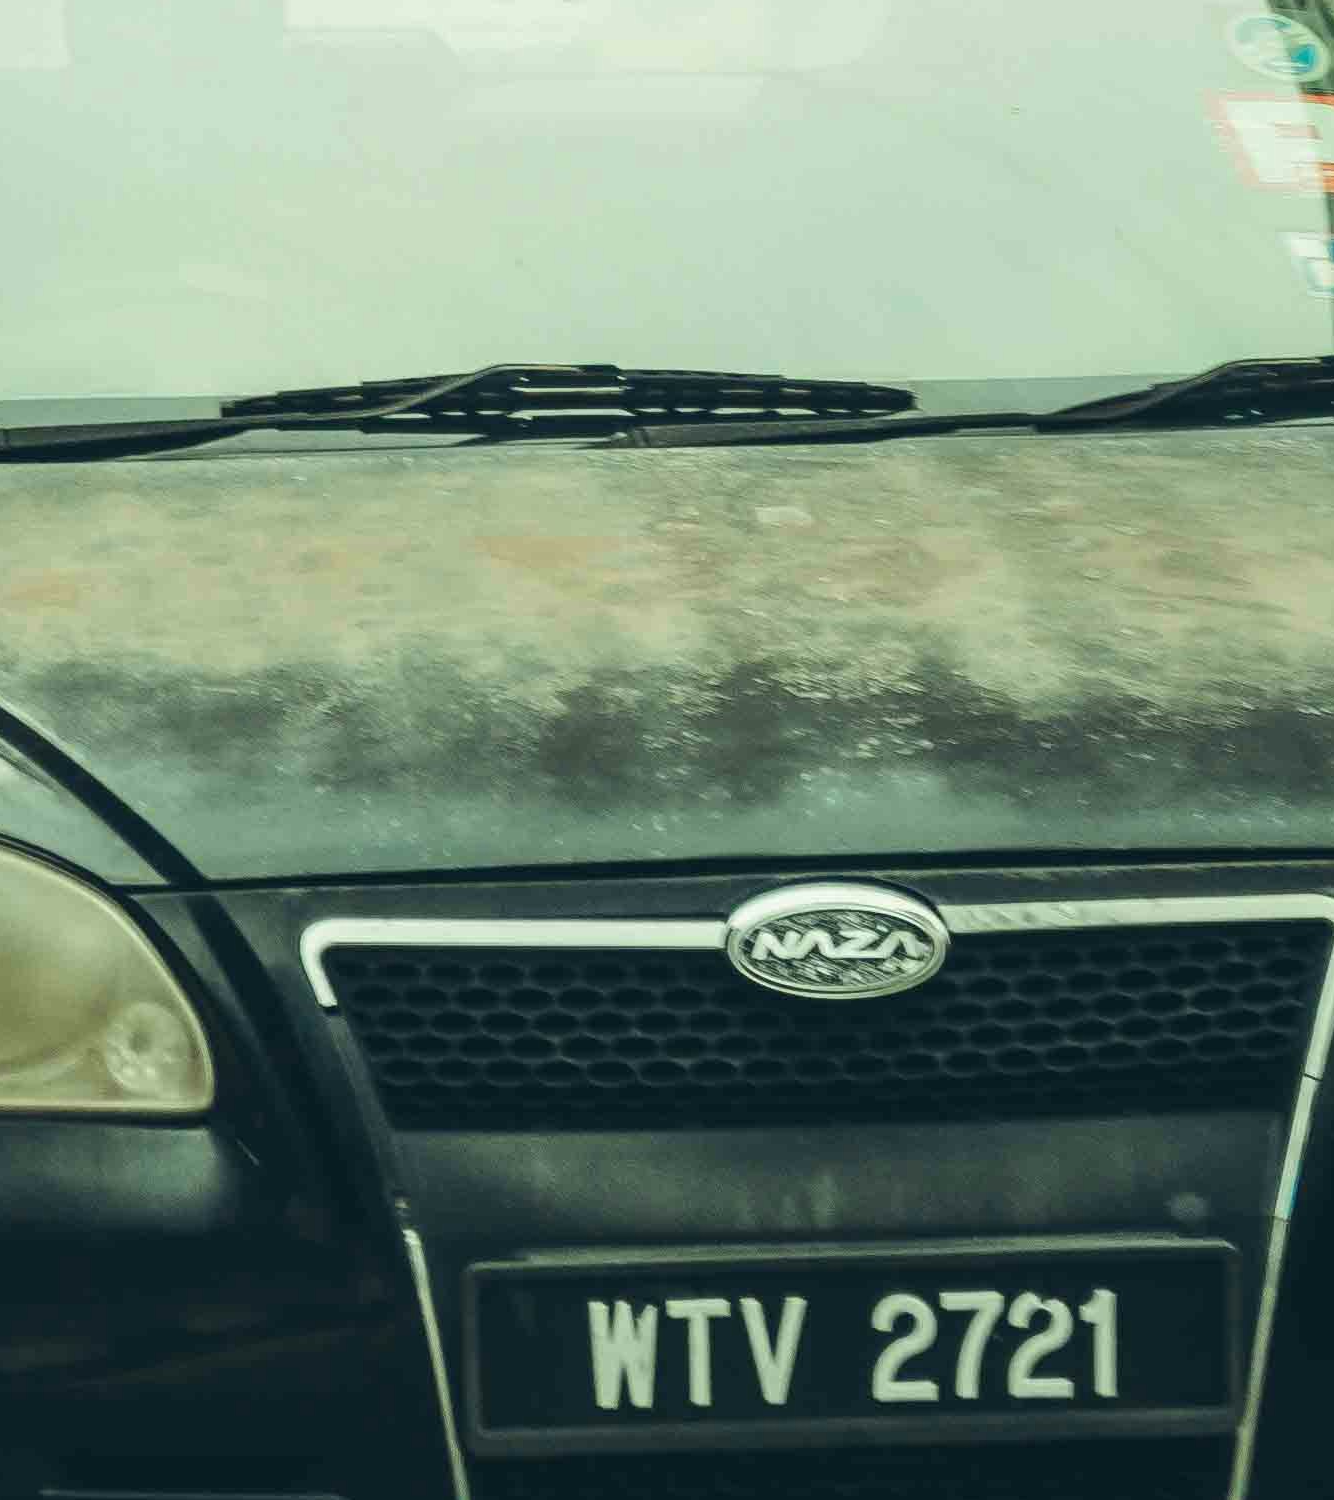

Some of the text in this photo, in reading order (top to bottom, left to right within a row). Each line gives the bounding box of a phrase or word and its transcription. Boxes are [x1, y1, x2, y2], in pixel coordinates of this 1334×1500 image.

[750, 928, 929, 961] NAZA
[587, 1288, 1118, 1409] WTV 2721
